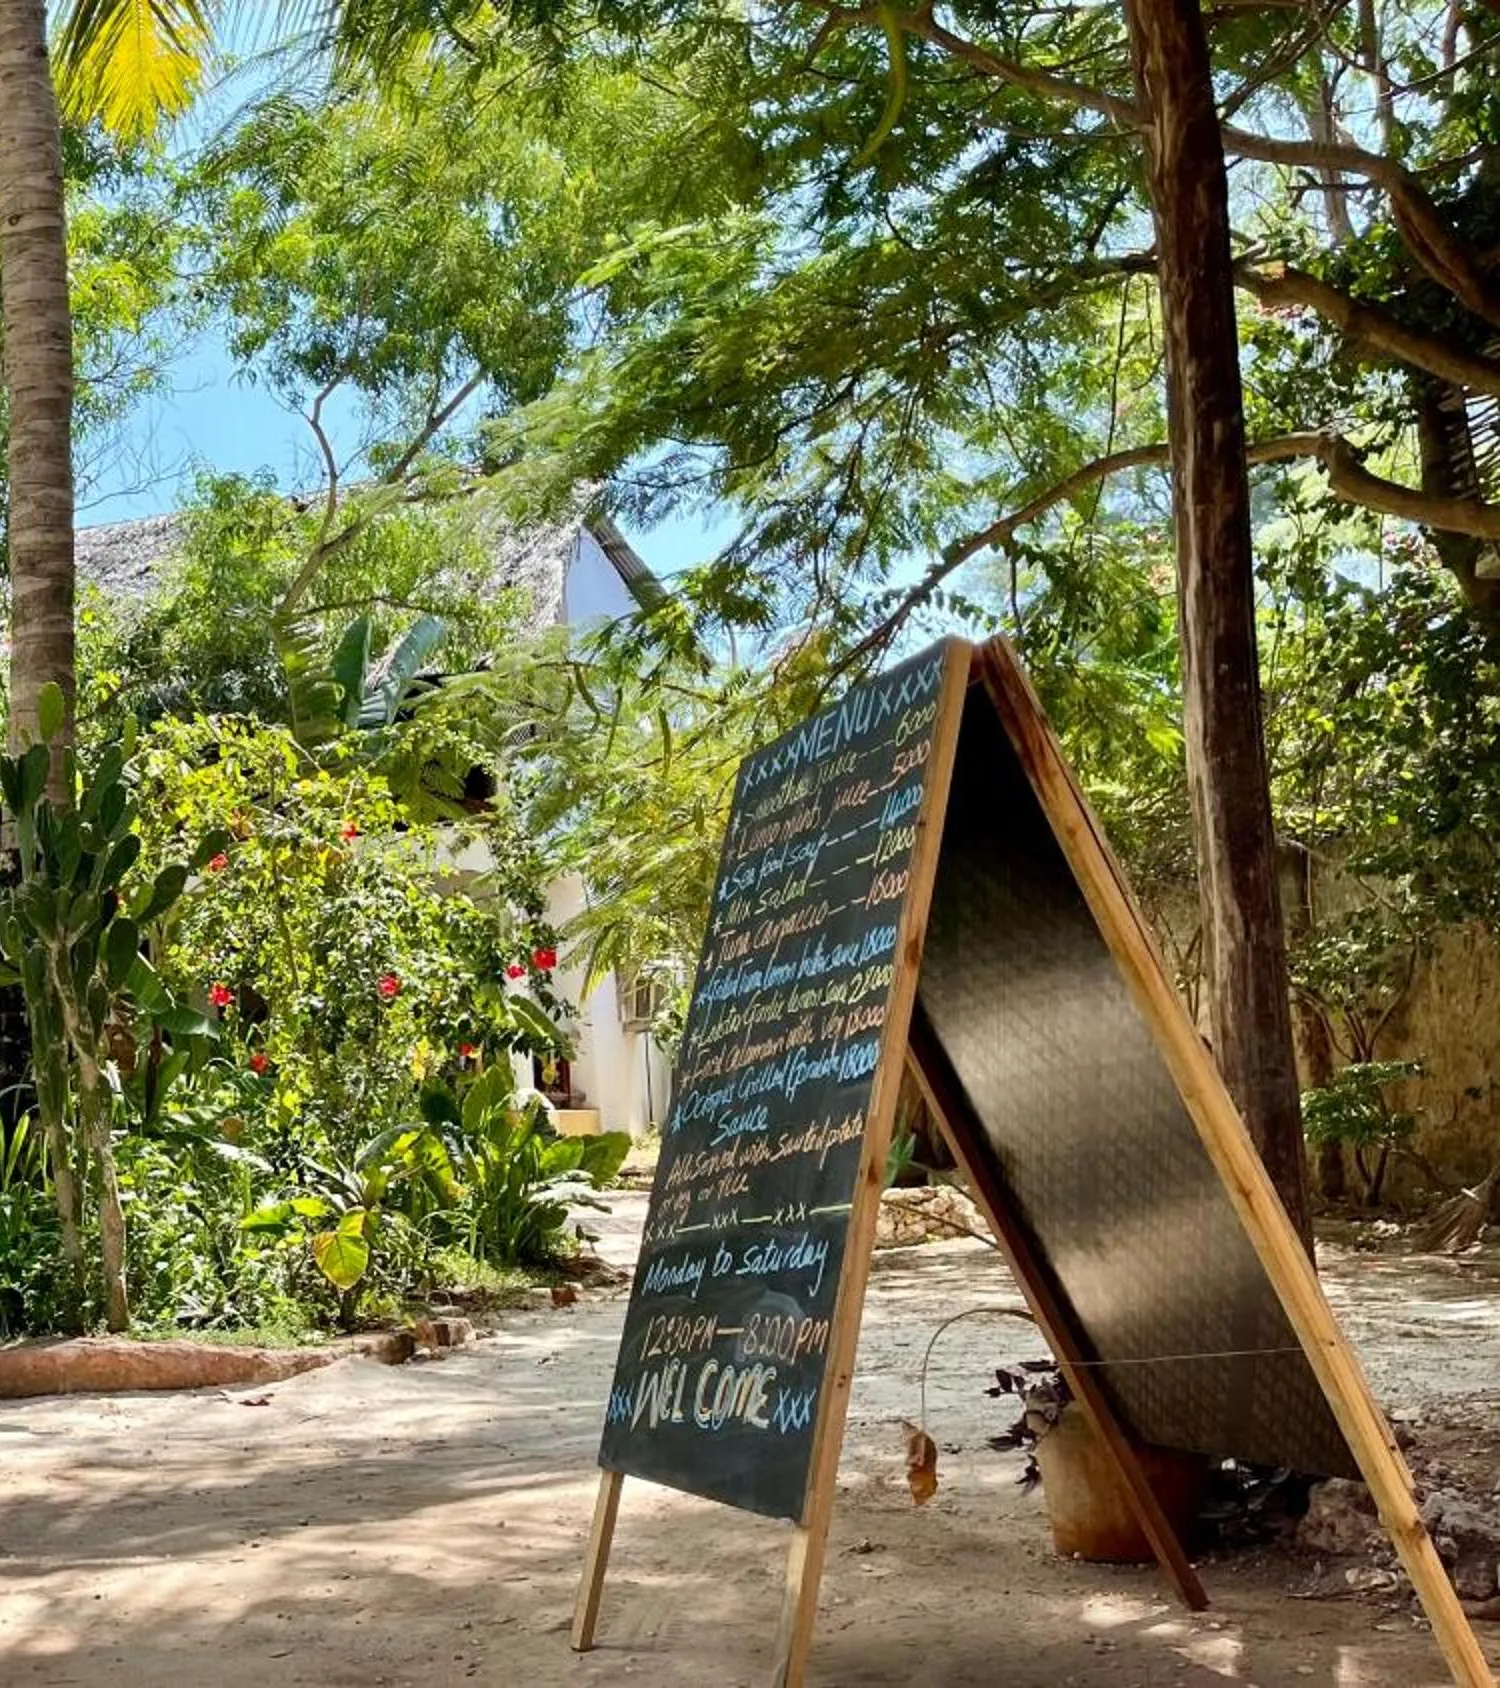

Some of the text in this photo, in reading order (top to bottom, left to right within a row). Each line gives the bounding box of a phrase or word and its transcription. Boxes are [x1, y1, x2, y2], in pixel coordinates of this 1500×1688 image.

[894, 701, 937, 747] 6000
[892, 739, 931, 775] 5000
[873, 825, 916, 868] 12000
[641, 1252, 707, 1299] Monday
[712, 1240, 733, 1277] to
